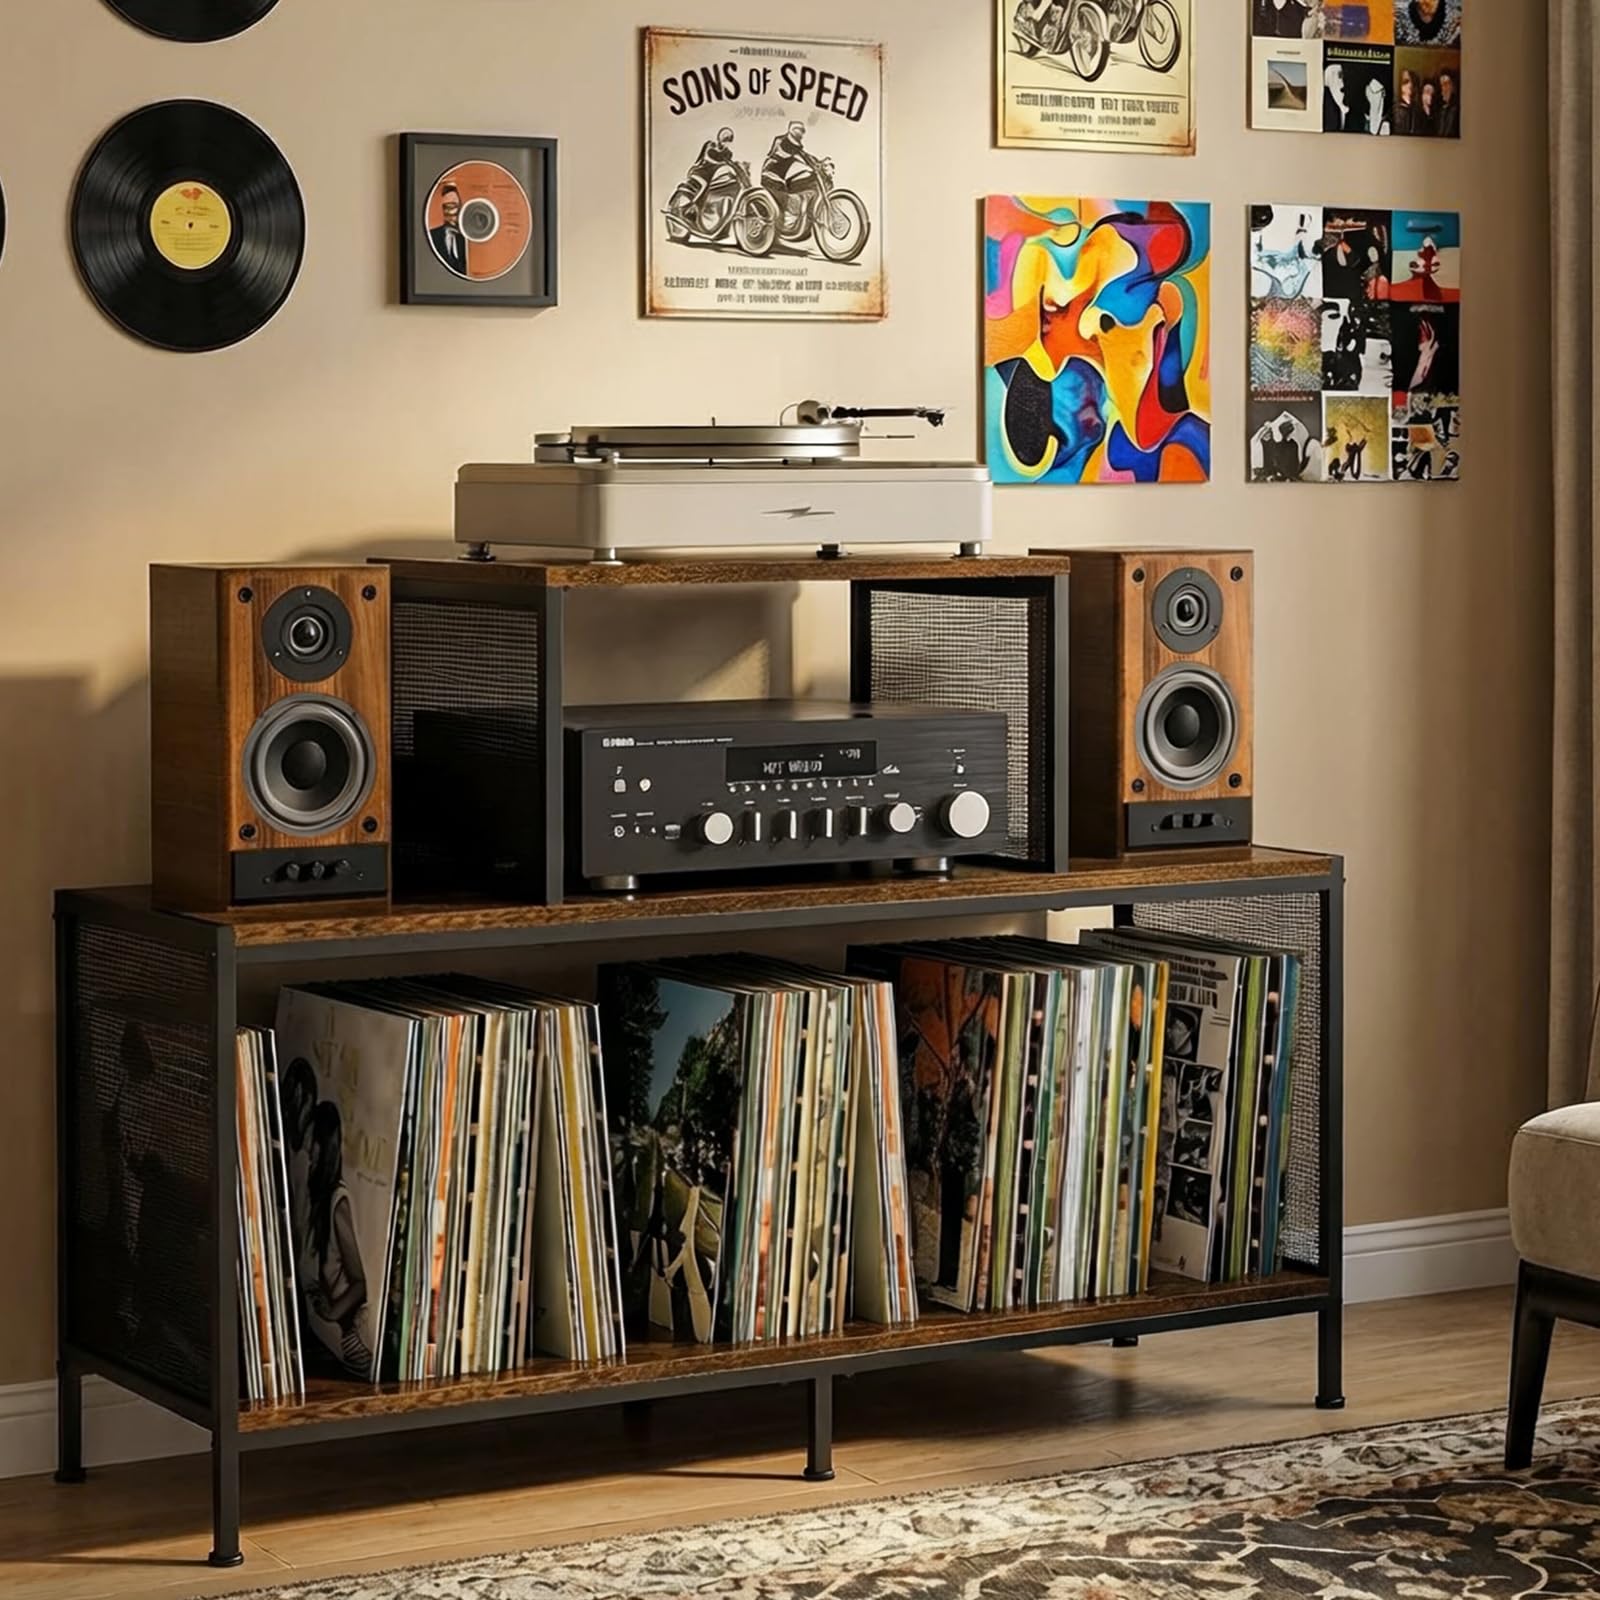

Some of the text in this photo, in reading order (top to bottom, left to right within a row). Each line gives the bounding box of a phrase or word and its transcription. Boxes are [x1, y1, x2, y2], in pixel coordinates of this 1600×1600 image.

[662, 61, 869, 122] SONS OF SPEED
